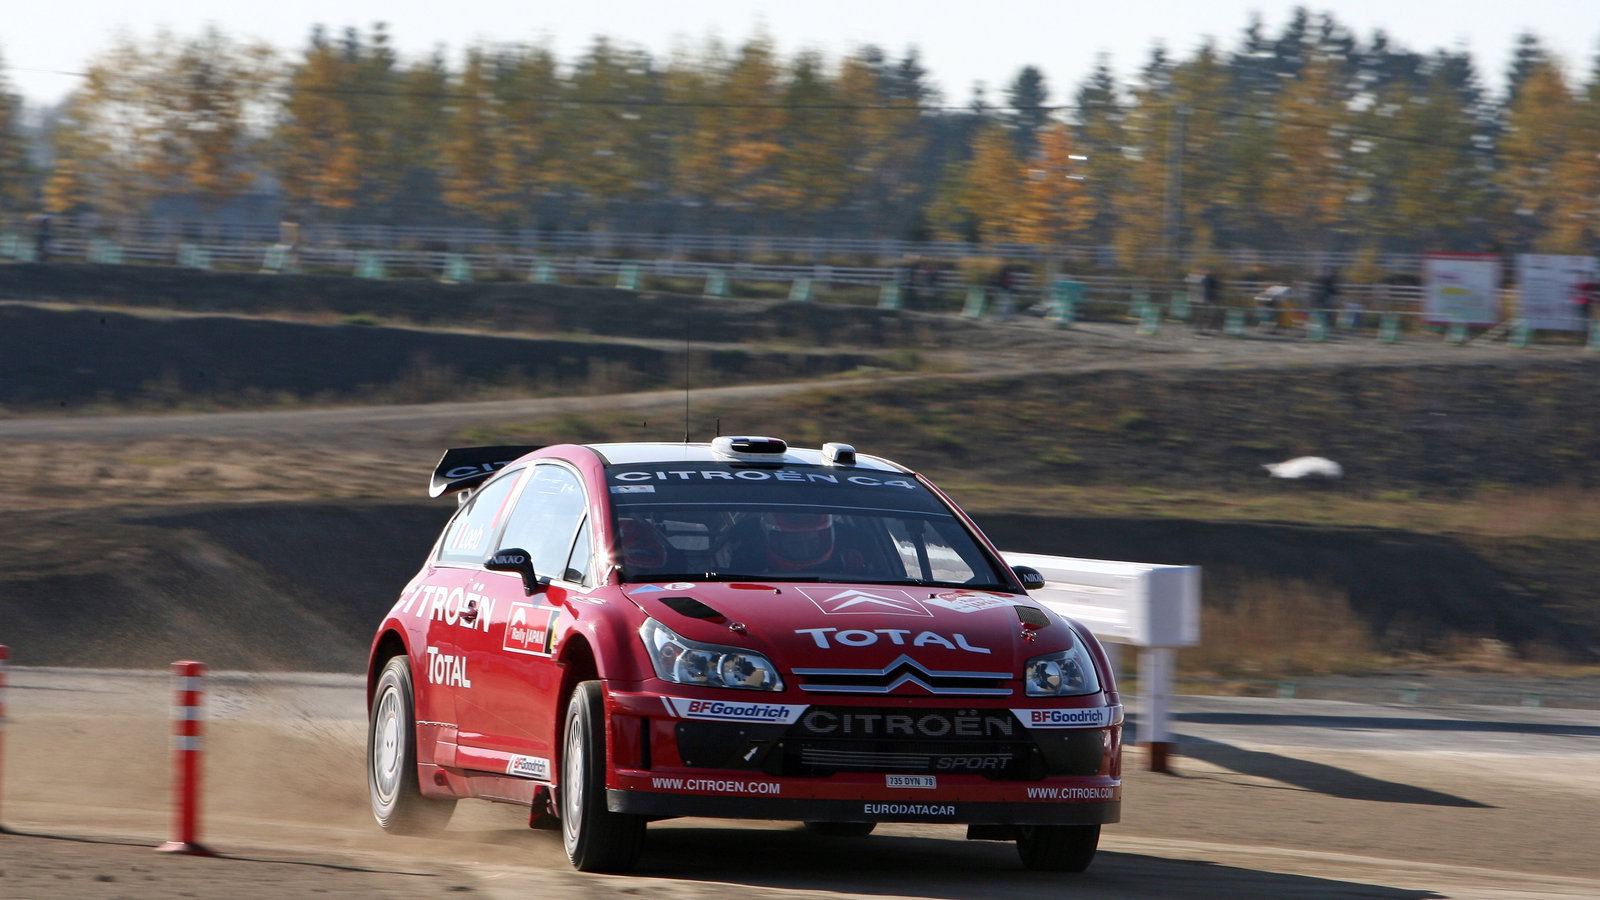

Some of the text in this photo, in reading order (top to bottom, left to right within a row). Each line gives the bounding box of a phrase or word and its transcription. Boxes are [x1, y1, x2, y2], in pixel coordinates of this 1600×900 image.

[614, 469, 917, 490] CITROËN C4
[491, 555, 525, 565] NIKKO
[390, 582, 497, 633] CITROËN
[511, 626, 527, 644] Rally
[523, 628, 546, 649] JAPAN
[793, 627, 992, 655] TOTAL
[427, 646, 472, 689] TOTAL
[687, 700, 791, 718] BFGoodrich
[1030, 709, 1103, 723] BFGoodrich
[802, 709, 1014, 737] CITROËN
[513, 756, 546, 773] BFGoodrich
[935, 756, 1013, 770] SPORT
[652, 777, 781, 794] WWW.CITROEN.COM
[889, 777, 934, 786] 735 DYN 78
[1026, 787, 1114, 799] WWW.CITROEN.COM
[863, 803, 956, 815] EURODATACAR
